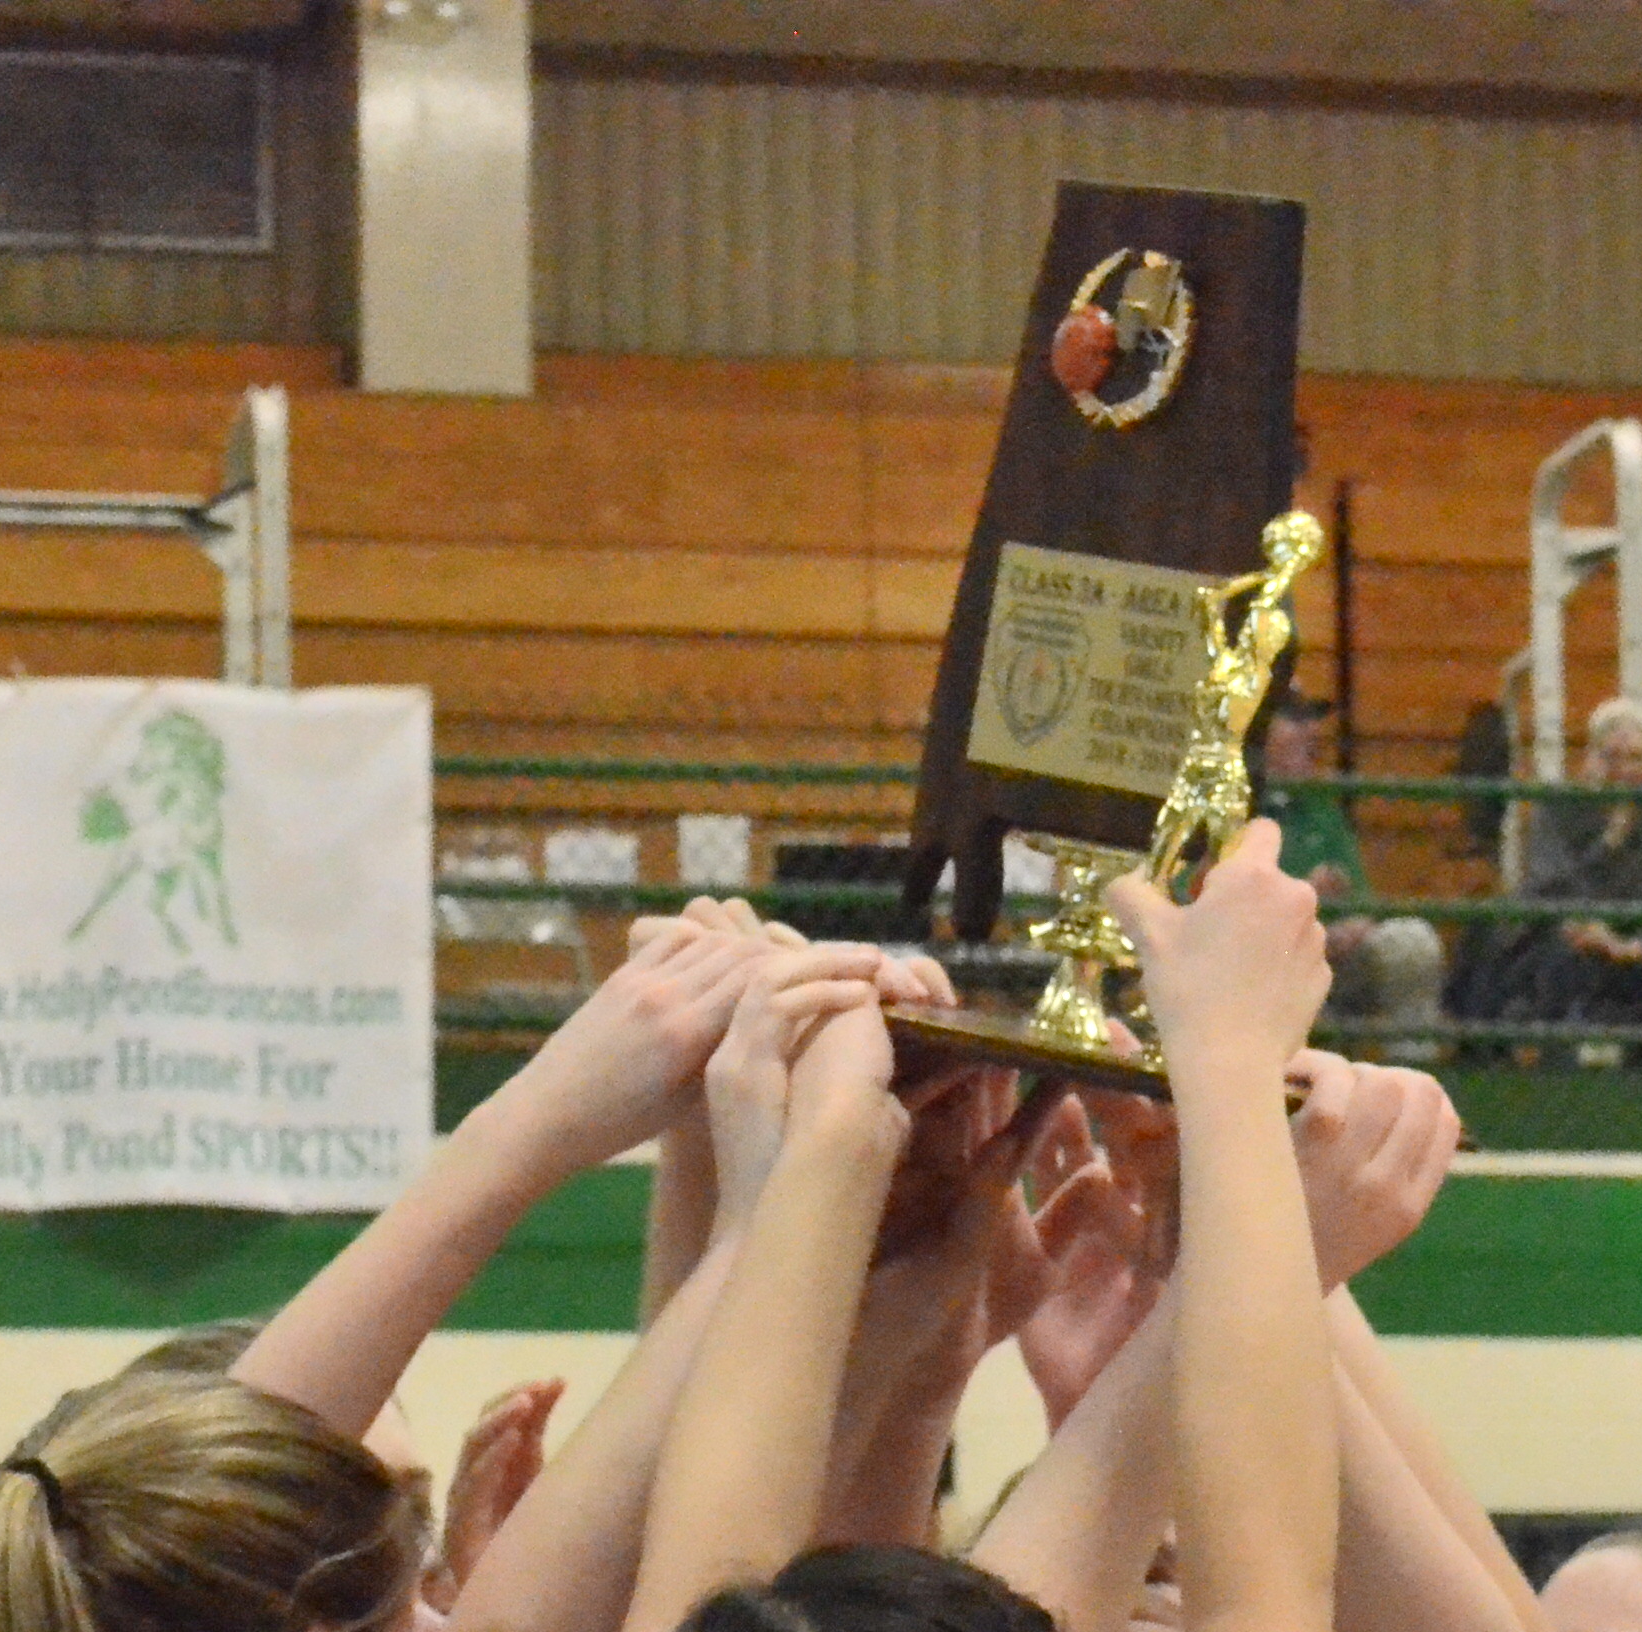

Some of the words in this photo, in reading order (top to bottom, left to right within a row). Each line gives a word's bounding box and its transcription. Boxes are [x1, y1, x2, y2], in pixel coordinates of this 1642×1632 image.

[114, 1036, 243, 1093] Home
[257, 1043, 336, 1099] For
[63, 1113, 175, 1174] Pond
[190, 1115, 401, 1180] SPORTS!!
